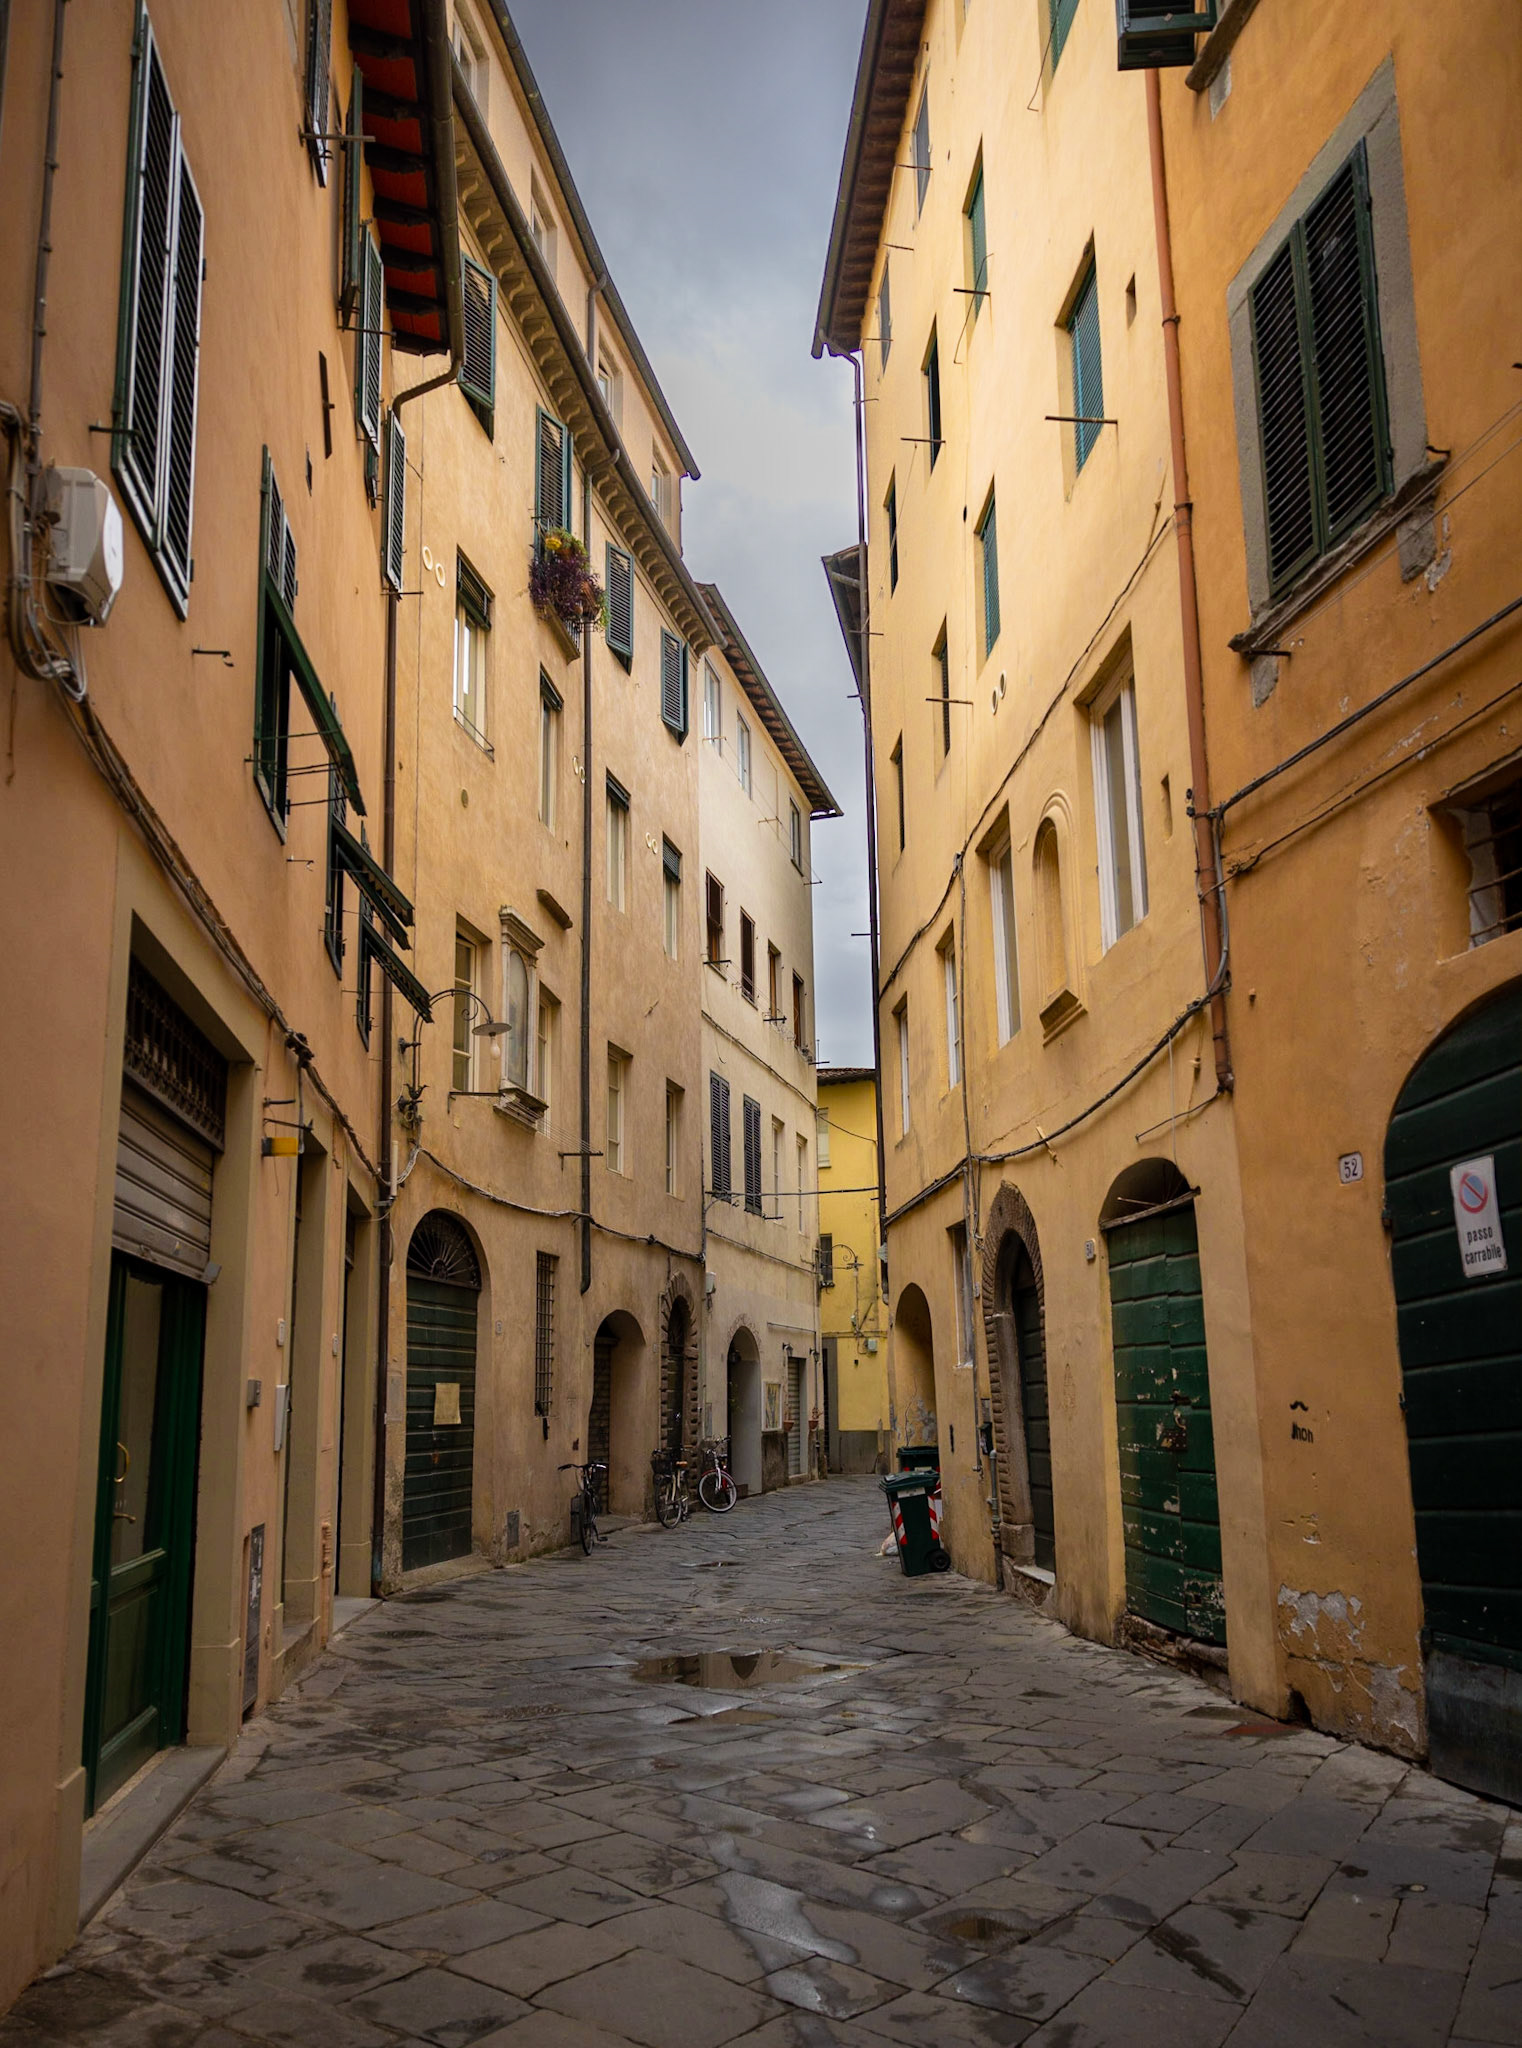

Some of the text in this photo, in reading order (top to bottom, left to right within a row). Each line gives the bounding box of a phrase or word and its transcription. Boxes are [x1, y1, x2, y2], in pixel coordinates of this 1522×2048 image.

[1344, 1158, 1358, 1178] 52
[1466, 1226, 1493, 1245] passo
[1464, 1244, 1502, 1265] carrabile
